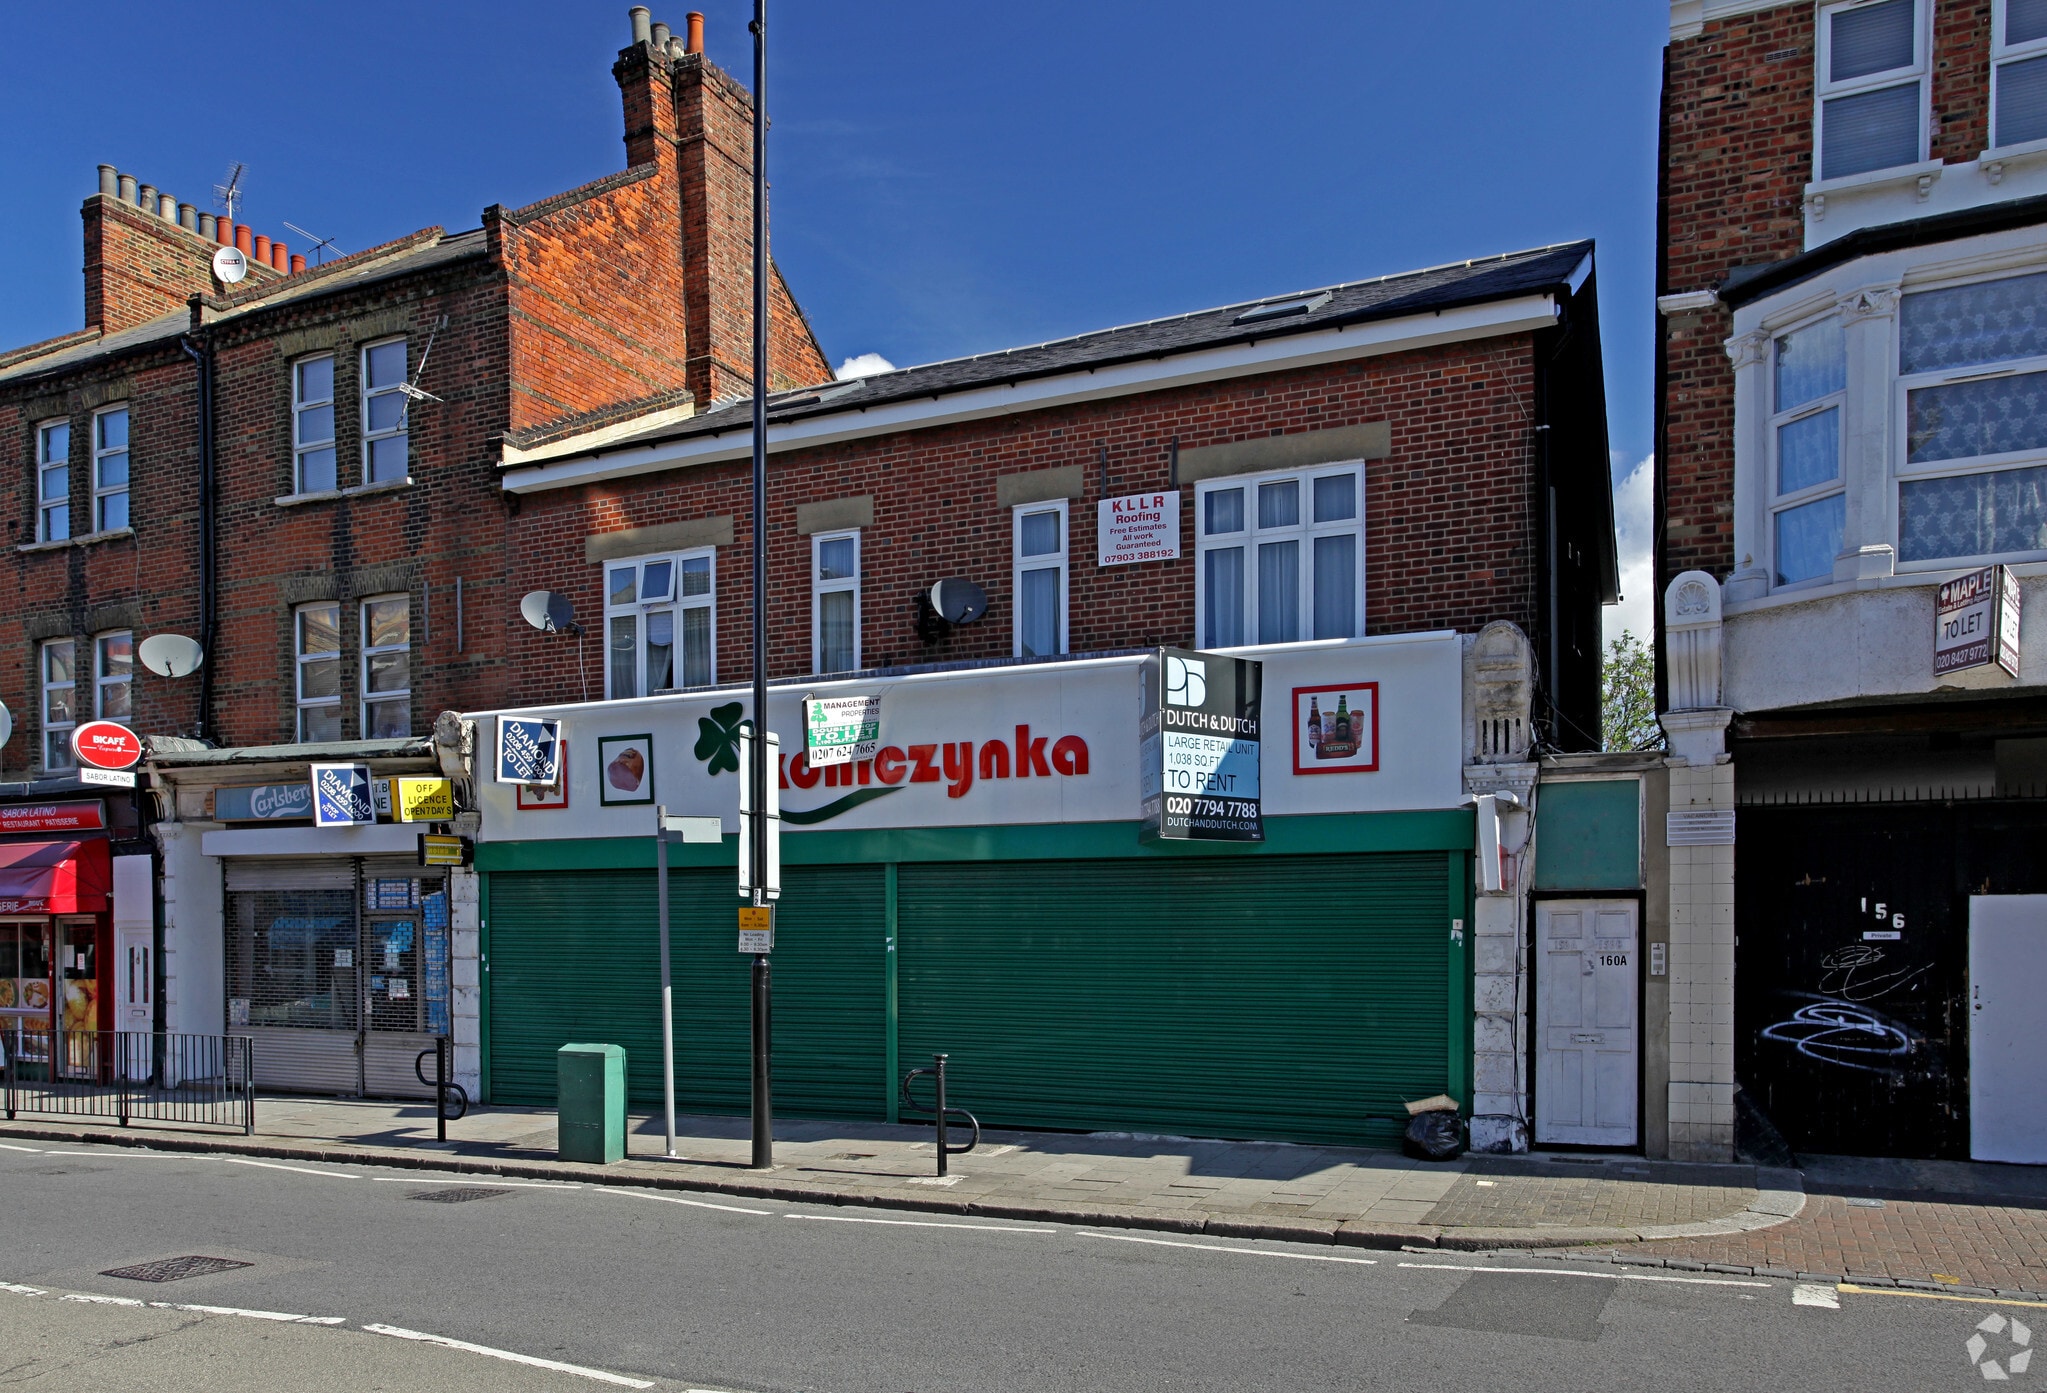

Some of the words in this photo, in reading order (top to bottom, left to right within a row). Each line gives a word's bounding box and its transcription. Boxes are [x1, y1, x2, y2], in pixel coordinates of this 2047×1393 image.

[1116, 511, 1161, 524] Roofing
[1109, 527, 1127, 535] Free
[1128, 523, 1167, 533] Estimates
[1134, 532, 1153, 540] work
[1116, 539, 1161, 550] Guaranteed
[1104, 553, 1135, 563] 07903
[1137, 549, 1174, 560] 388192
[1950, 569, 1992, 603] MAPLE
[1944, 619, 1959, 640] TO
[1961, 612, 1983, 636] LET
[1936, 654, 1950, 669] 020
[1951, 647, 1968, 665] 8427
[1969, 643, 1988, 661] 9772
[823, 698, 880, 709] MANAGEMENT
[841, 708, 880, 717] PROPERTIES
[812, 725, 850, 734] DOUBLE
[853, 723, 876, 731] SHOP
[1167, 709, 1208, 729] DUTCH
[1209, 714, 1219, 730] &
[1220, 715, 1257, 735] DUTCH
[812, 731, 839, 742] TO
[845, 727, 876, 739] LET
[509, 722, 554, 774] DIAMOND
[812, 748, 834, 760] 0207
[836, 745, 852, 757] 624
[855, 742, 876, 755] 7665
[1168, 736, 1201, 750] LARGE
[1203, 739, 1233, 753] RETAIL
[1235, 741, 1255, 755] UNIT
[503, 747, 517, 763] TO
[514, 761, 531, 778] LET
[506, 732, 523, 750] 0208
[521, 750, 534, 762] 459
[531, 762, 546, 778] 1000
[1169, 752, 1191, 765] 1,038
[1194, 754, 1221, 768] SQ.FT
[86, 772, 108, 781] SABOR
[109, 775, 131, 783] LATINO
[1168, 769, 1191, 789] TO
[1196, 771, 1237, 792] RENT
[324, 770, 372, 815] DIAMOND
[416, 784, 433, 793] OFF
[320, 779, 337, 796] 0208
[335, 794, 349, 806] 459
[348, 804, 364, 820] 1000
[408, 795, 447, 805] LICENCE
[2, 808, 28, 818] SABOR
[29, 806, 57, 816] LATINO
[321, 804, 330, 813] TO
[329, 810, 338, 820] LET
[326, 802, 340, 814] SHOP
[404, 807, 425, 816] OPEN
[426, 807, 431, 815] 7
[431, 806, 452, 815] DAYS
[1167, 796, 1192, 814] 020
[1194, 799, 1225, 817] 7794
[1227, 801, 1257, 819] 7788
[2, 819, 41, 828] RESTAURANT
[45, 816, 79, 826] PATISSERIE
[1167, 816, 1258, 831] DUTCHANDDUTCH.COM
[1599, 955, 1628, 966] 160A
